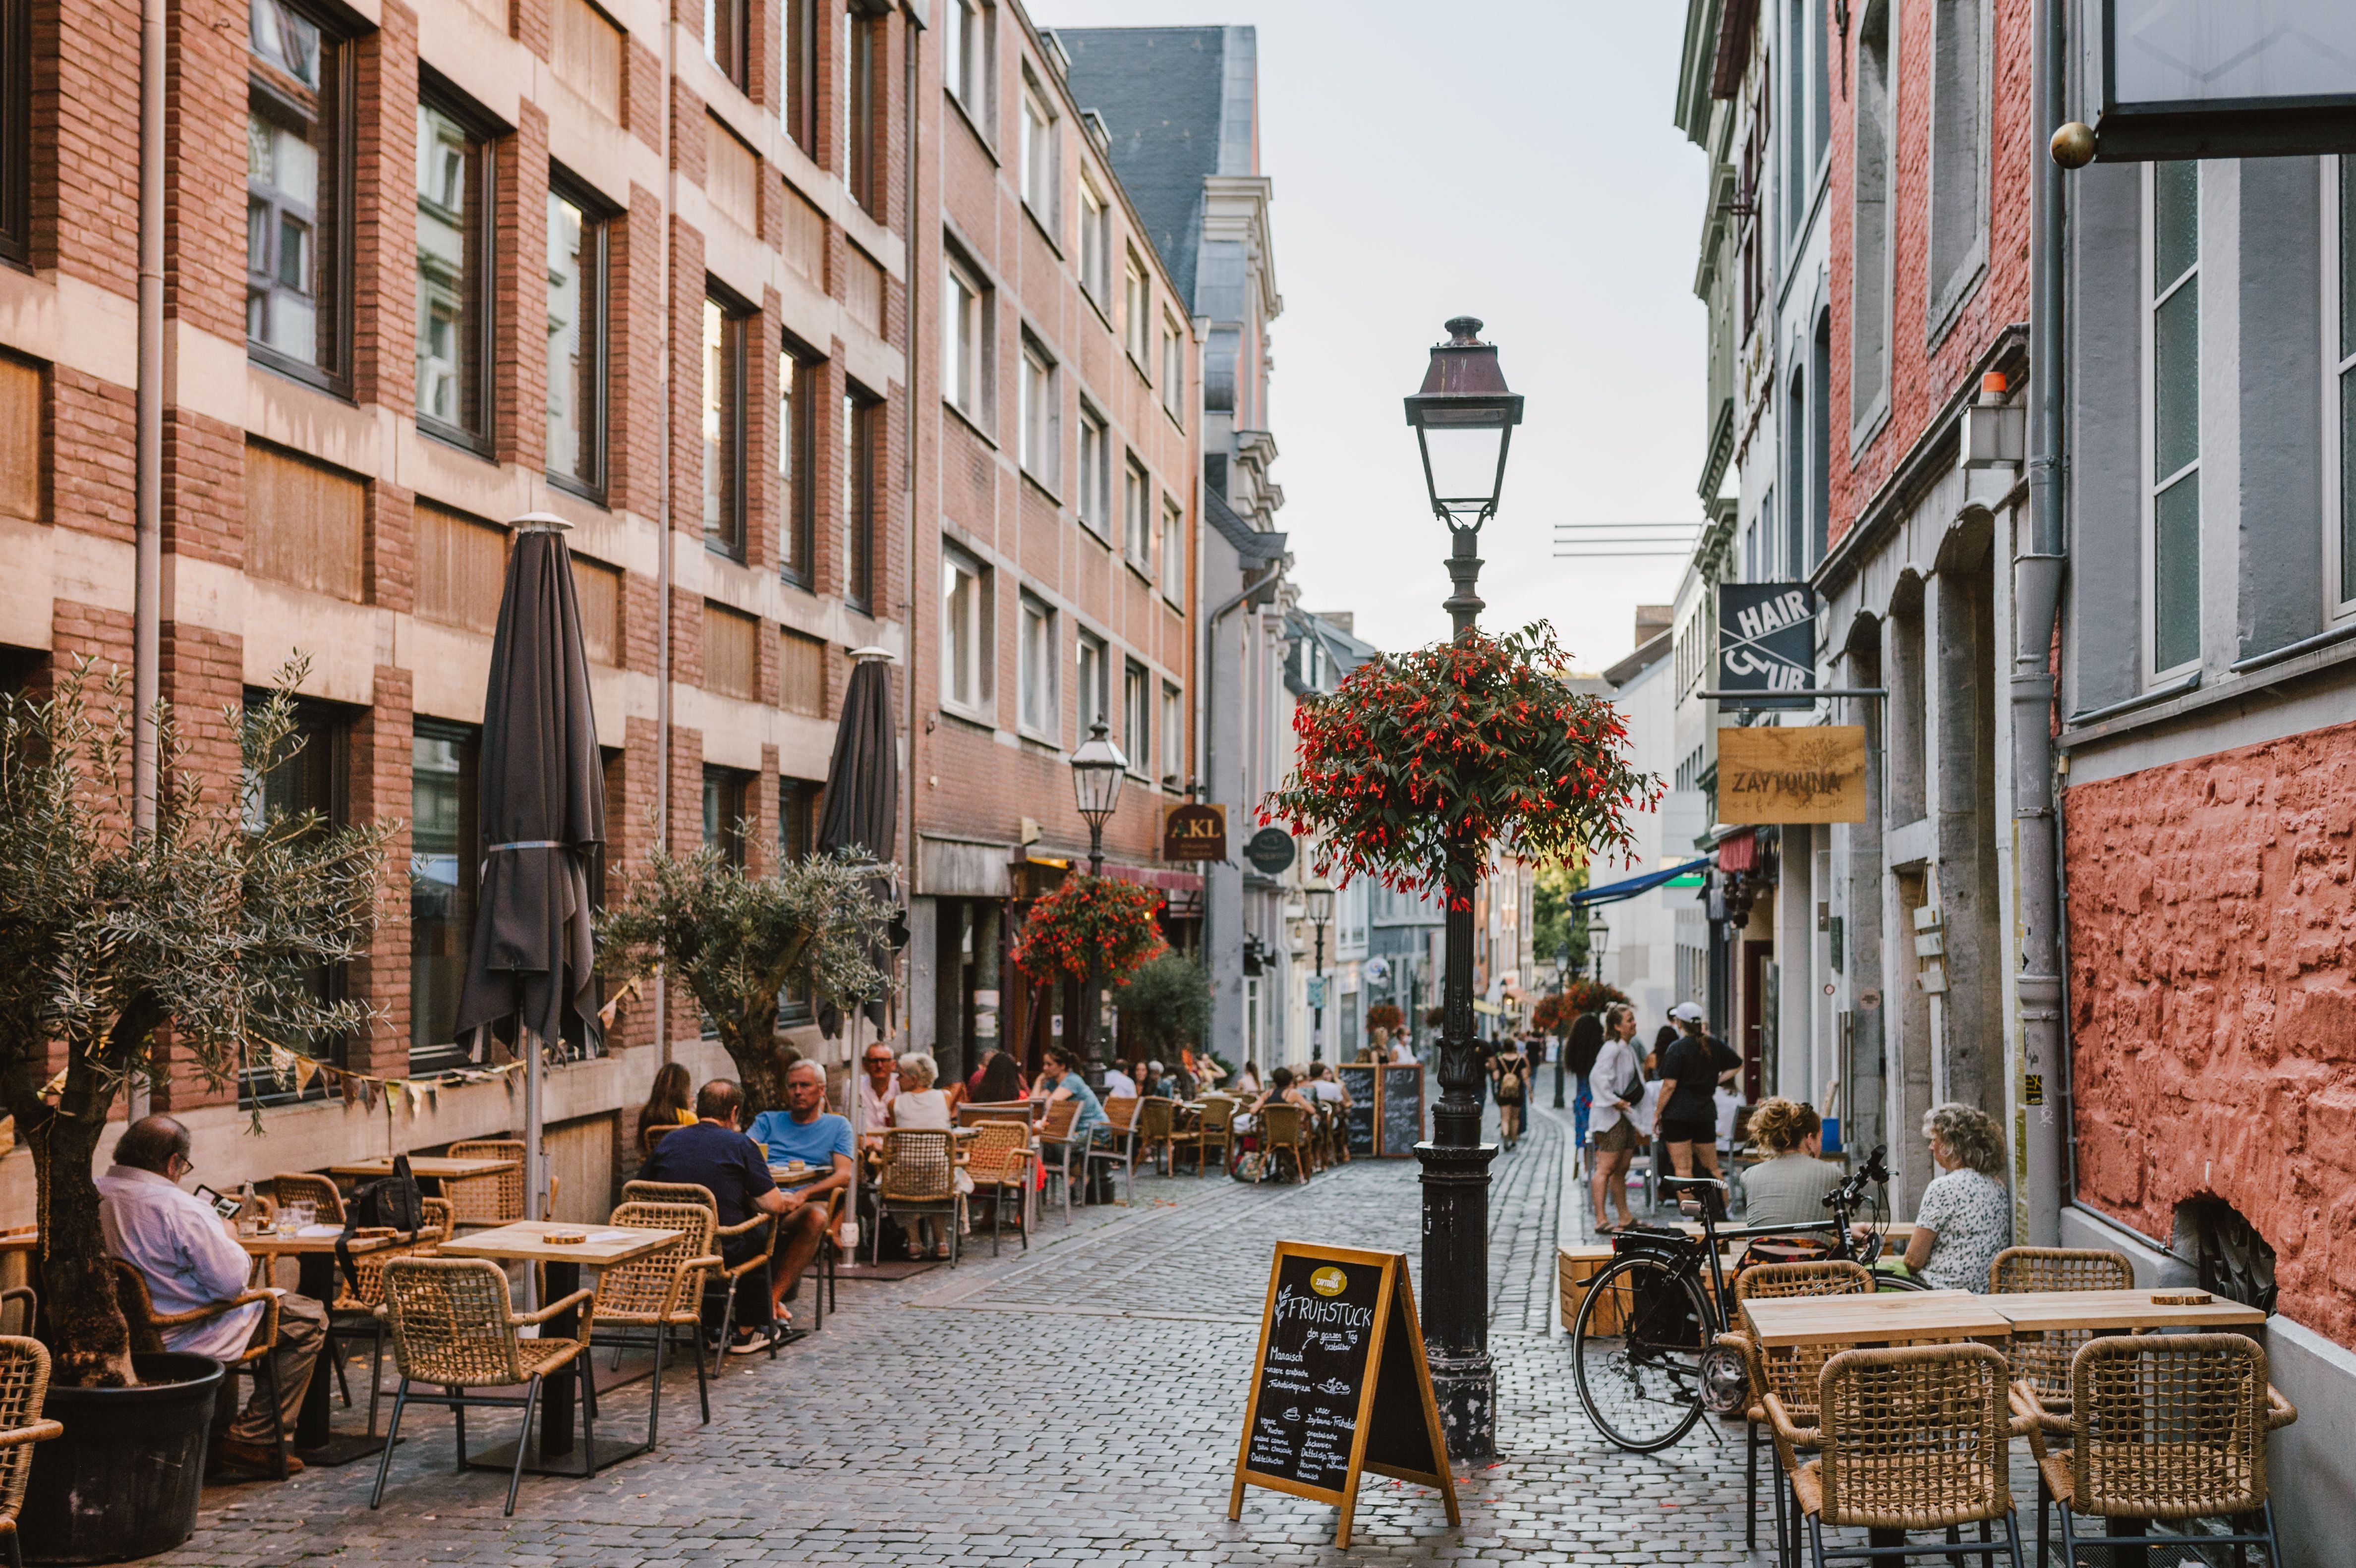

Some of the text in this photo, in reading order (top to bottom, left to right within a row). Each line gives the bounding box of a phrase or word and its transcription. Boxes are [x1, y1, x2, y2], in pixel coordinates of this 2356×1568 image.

[1737, 590, 1810, 639] HAIR
[1725, 649, 1805, 690] CLUB
[1732, 772, 1841, 794] ZAYTOUNA
[1170, 819, 1221, 838] AKL
[1288, 1296, 1372, 1327] FRÜHSTÜCK
[1307, 1327, 1358, 1344] den ganzen Tag
[1324, 1342, 1351, 1352] bestellbar
